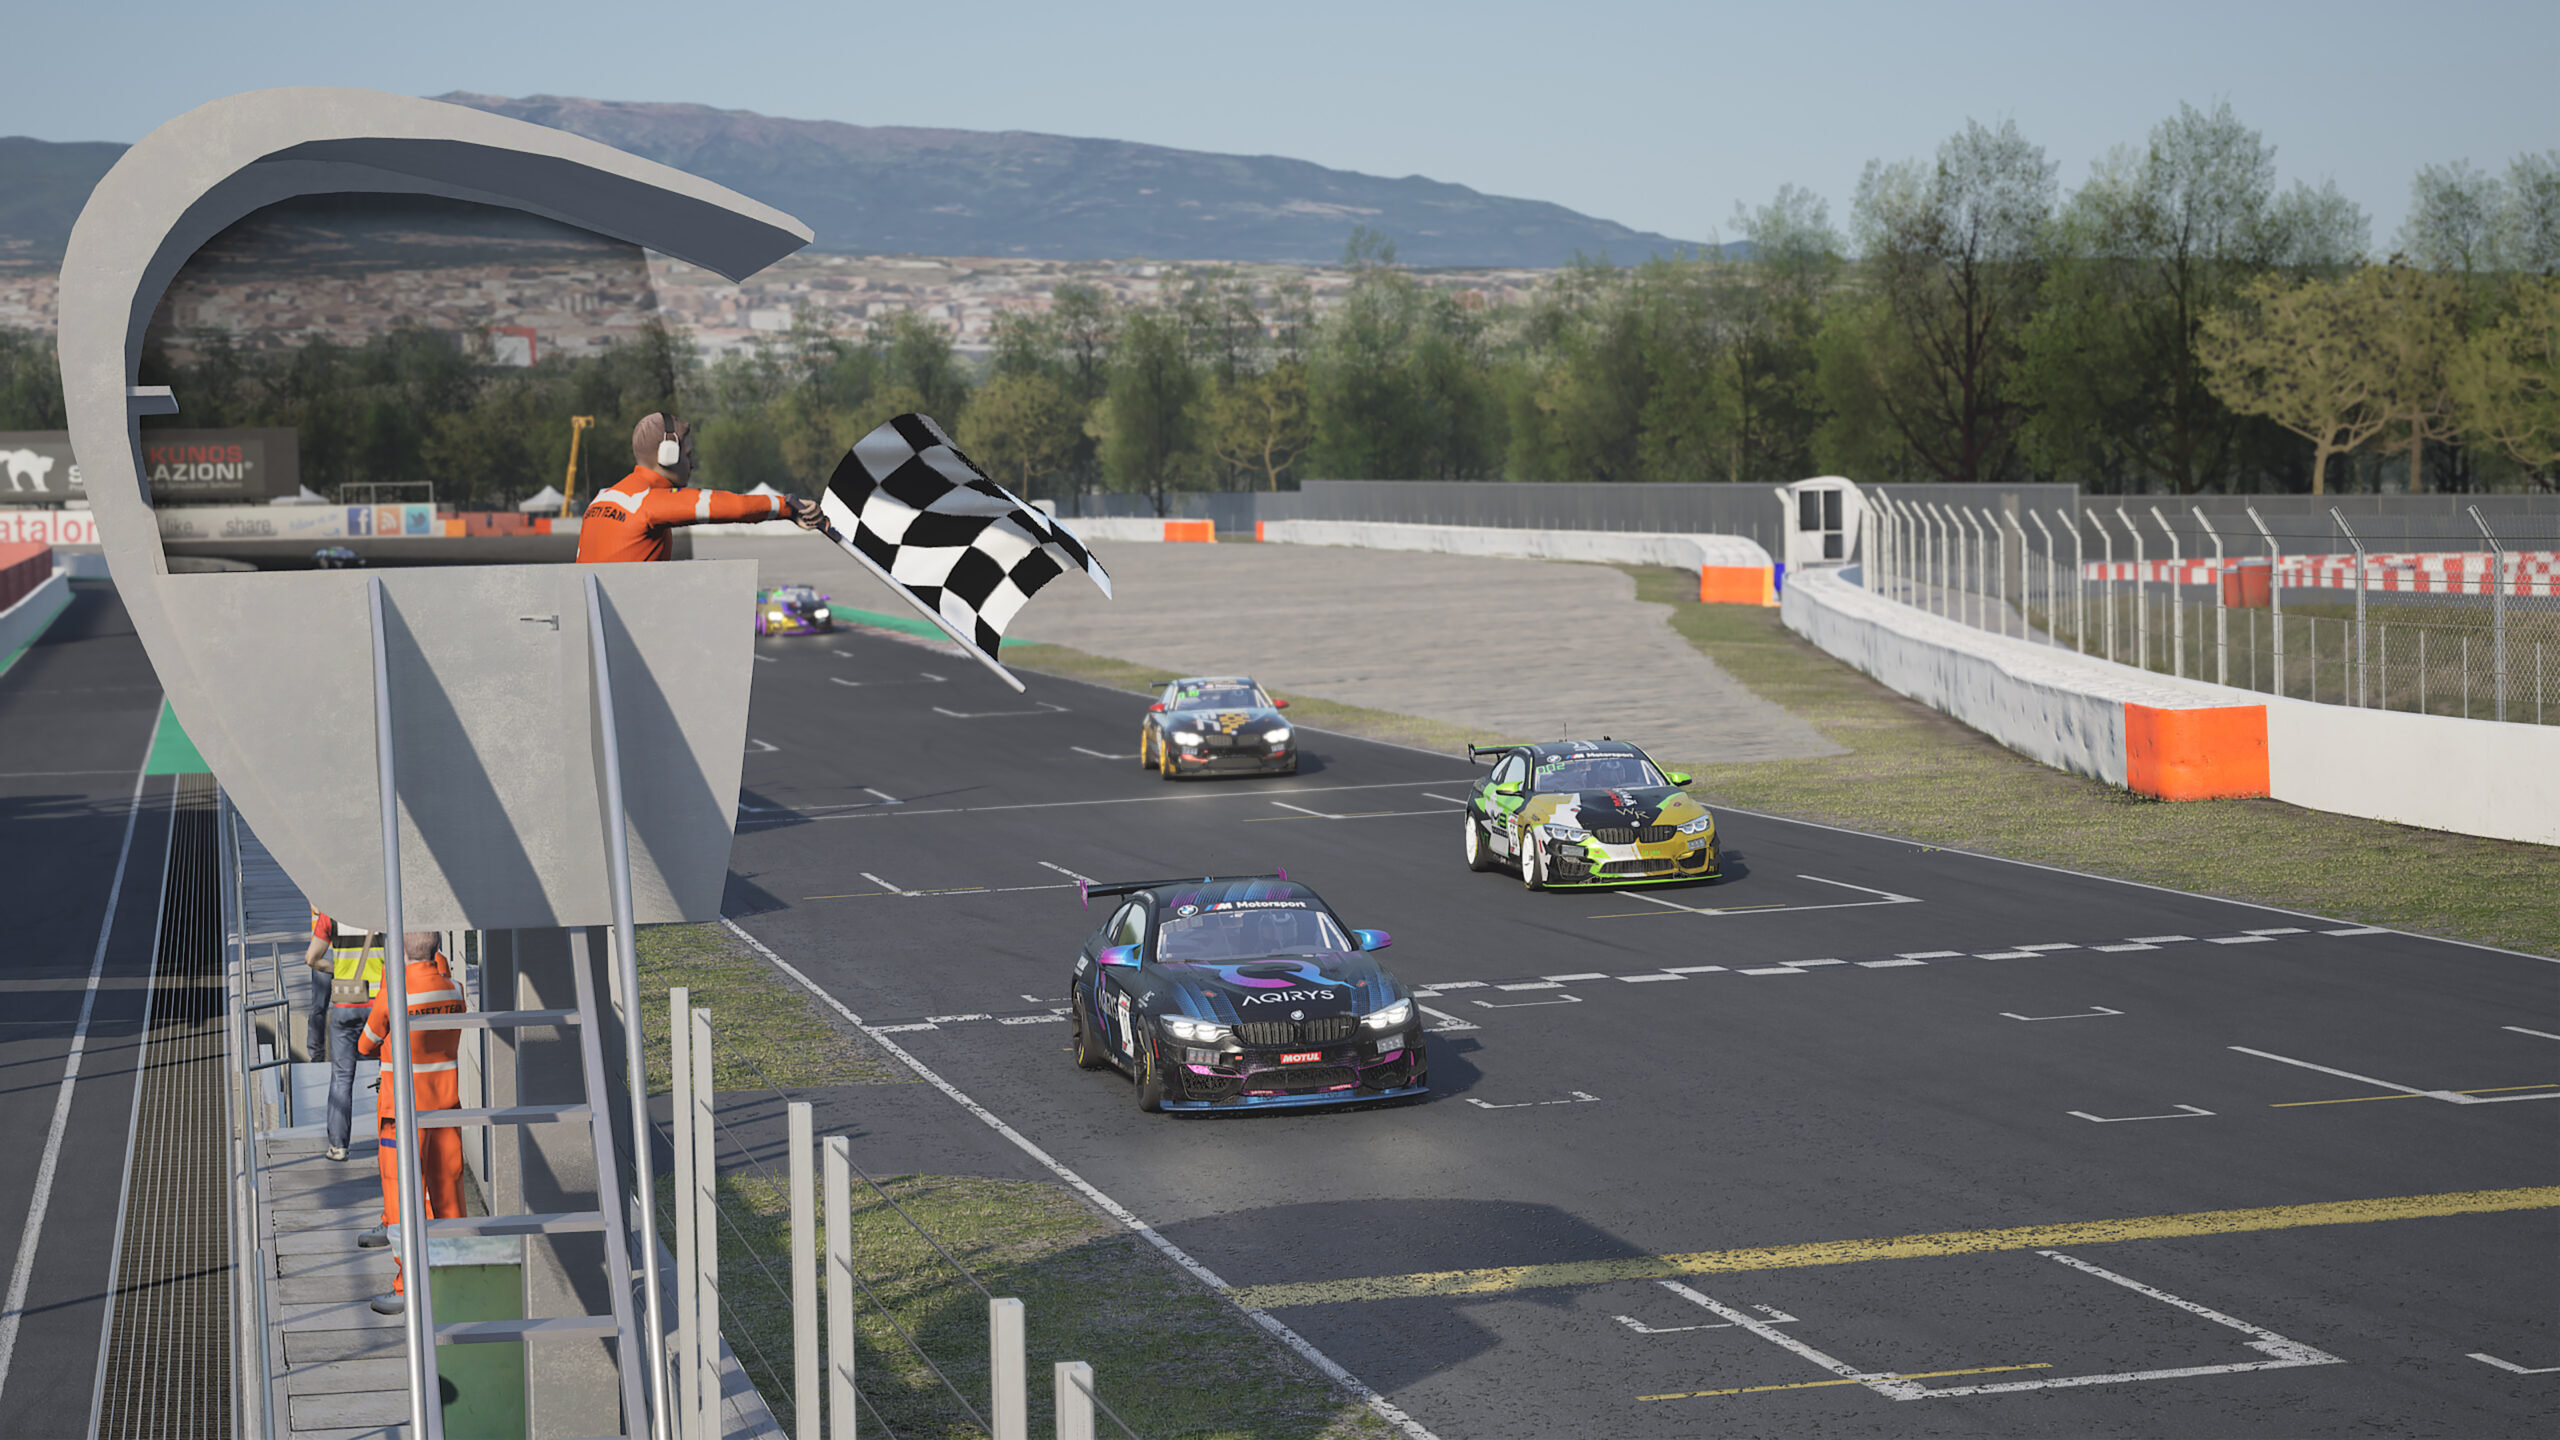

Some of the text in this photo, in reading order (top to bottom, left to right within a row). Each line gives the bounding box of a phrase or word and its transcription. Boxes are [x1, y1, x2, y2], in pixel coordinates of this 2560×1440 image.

[151, 445, 243, 463] KUNOS
[603, 507, 626, 522] TEAM
[166, 518, 194, 534] like
[226, 516, 272, 535] share
[1536, 762, 1566, 775] 002
[1236, 901, 1307, 909] Motorsport
[1242, 989, 1335, 1007] AQIRYS
[1282, 1053, 1320, 1063] MOTUL
